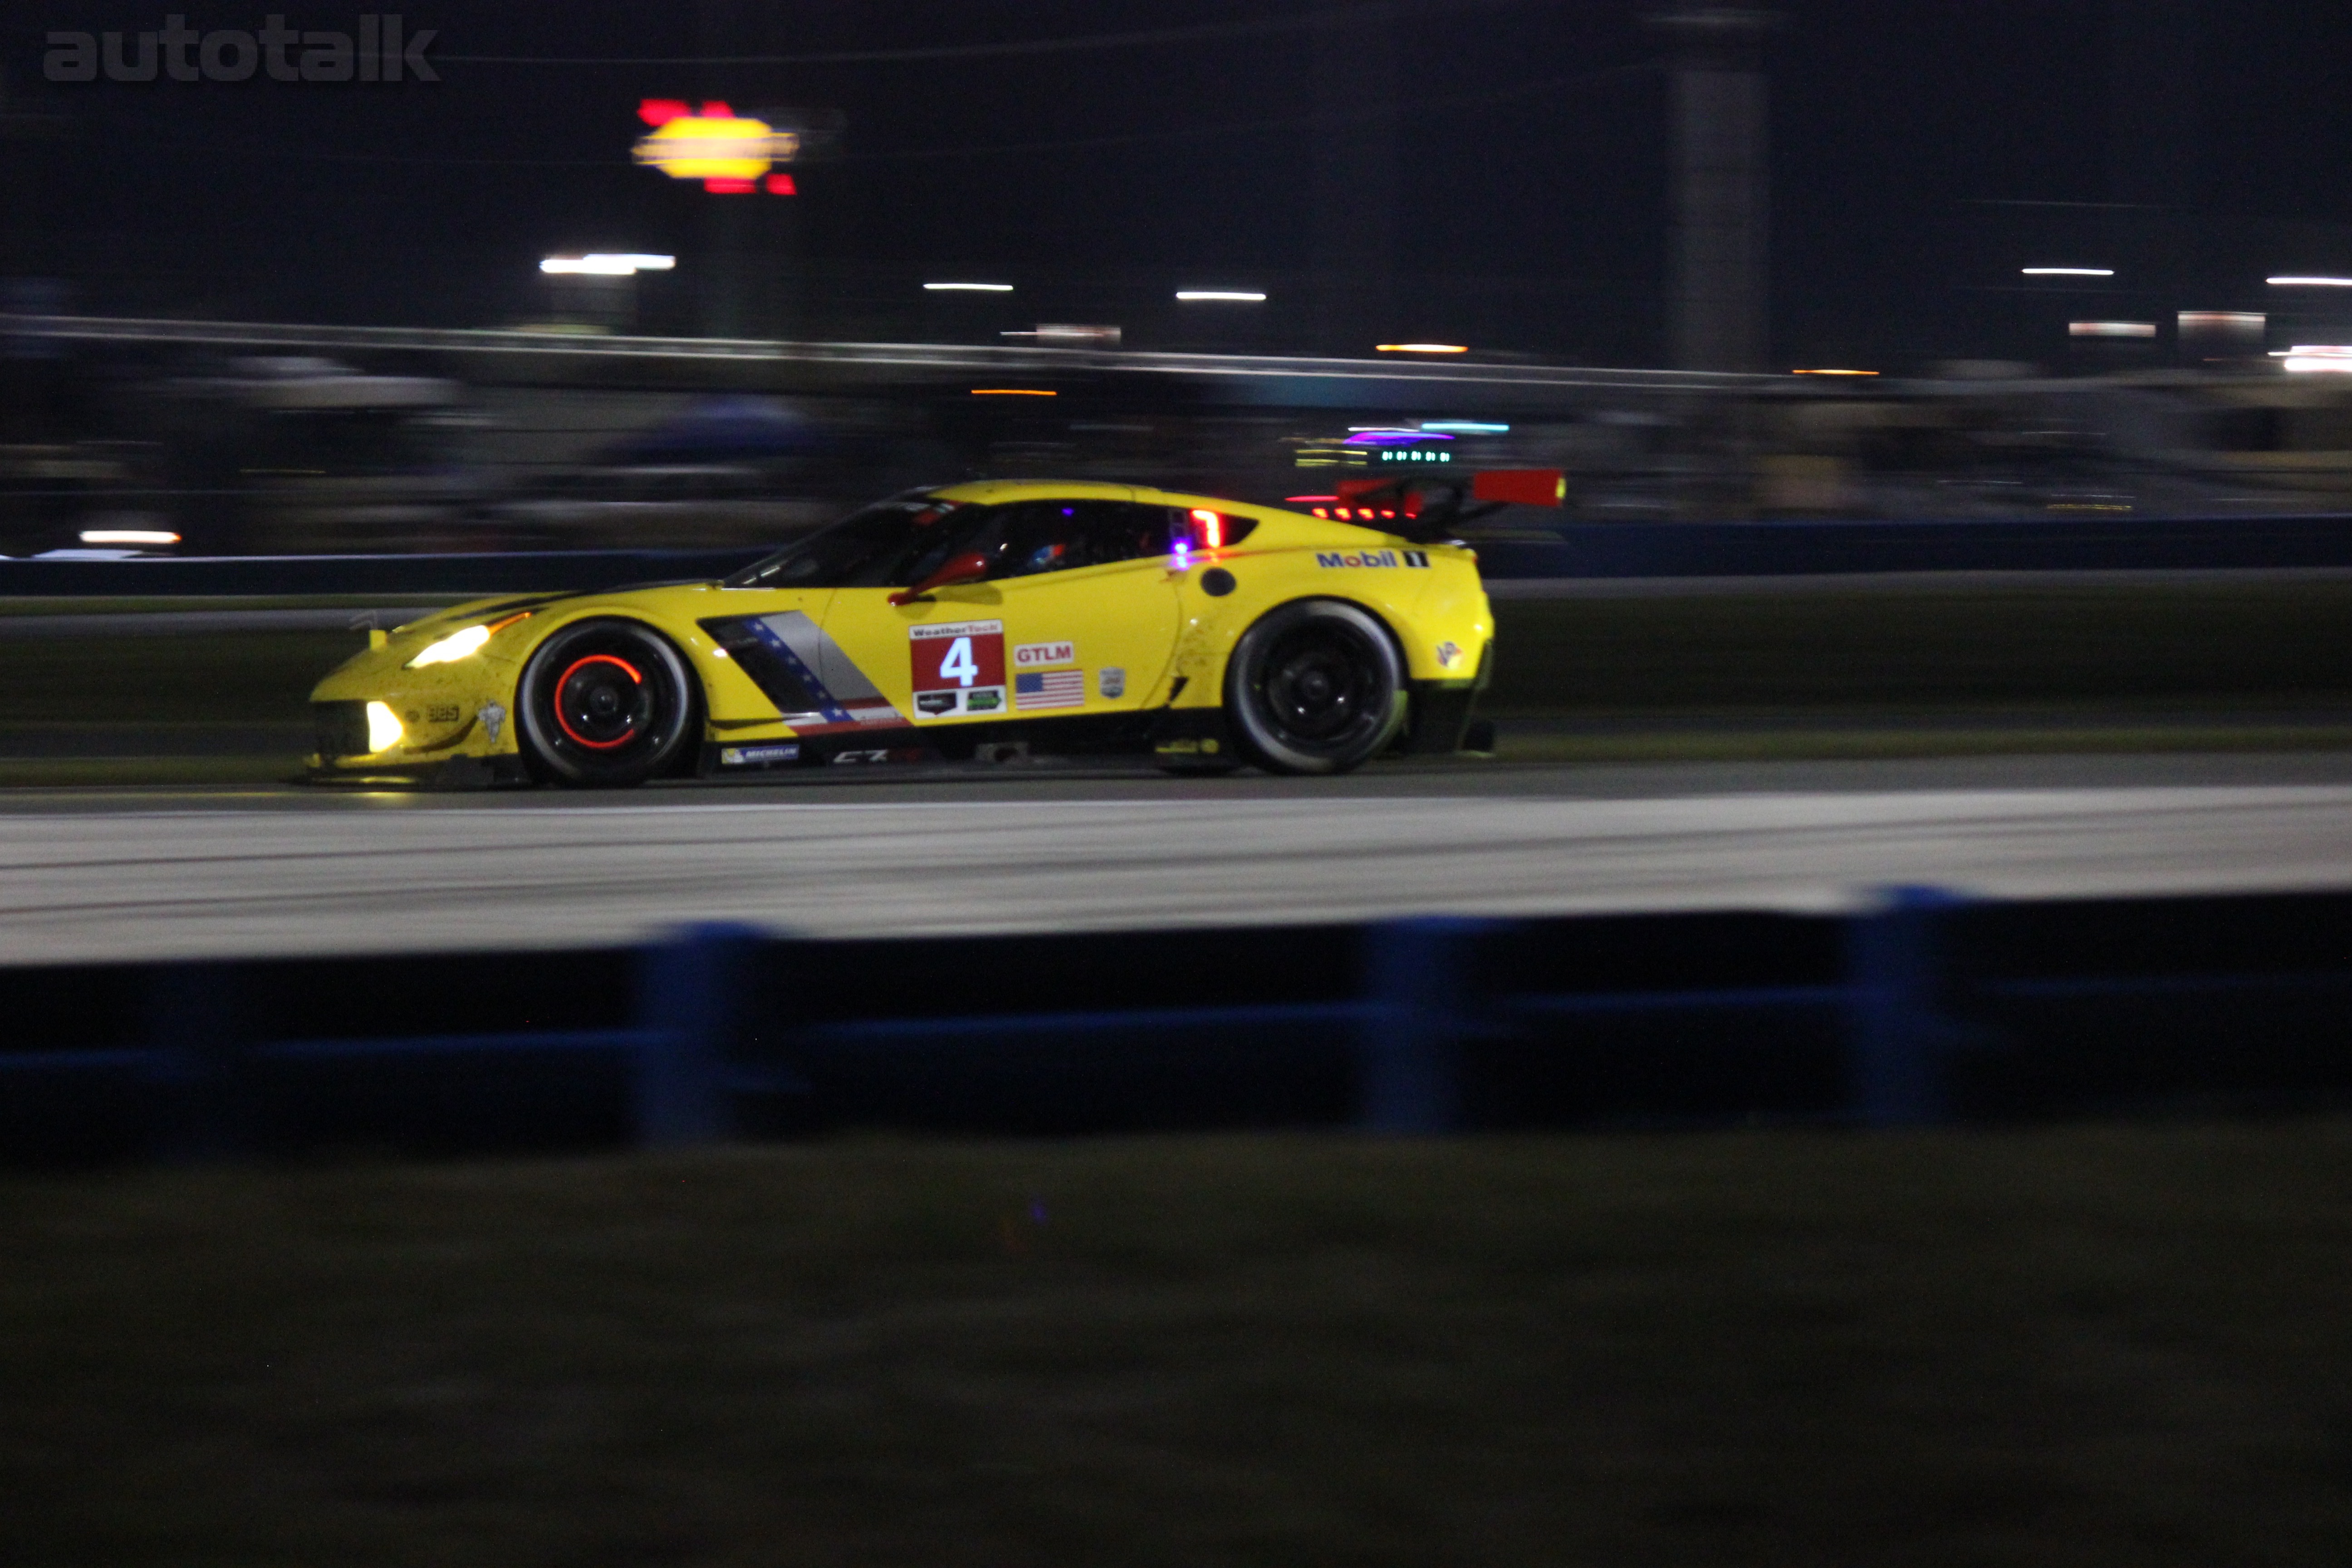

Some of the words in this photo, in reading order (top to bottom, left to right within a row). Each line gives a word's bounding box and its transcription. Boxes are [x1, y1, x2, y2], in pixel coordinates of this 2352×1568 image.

[1316, 550, 1397, 567] Mobil
[1407, 550, 1426, 567] 1
[913, 624, 998, 636] WeatherTech
[939, 636, 978, 687] 4
[1017, 645, 1071, 663] GTLM
[746, 747, 799, 758] MICHELIN
